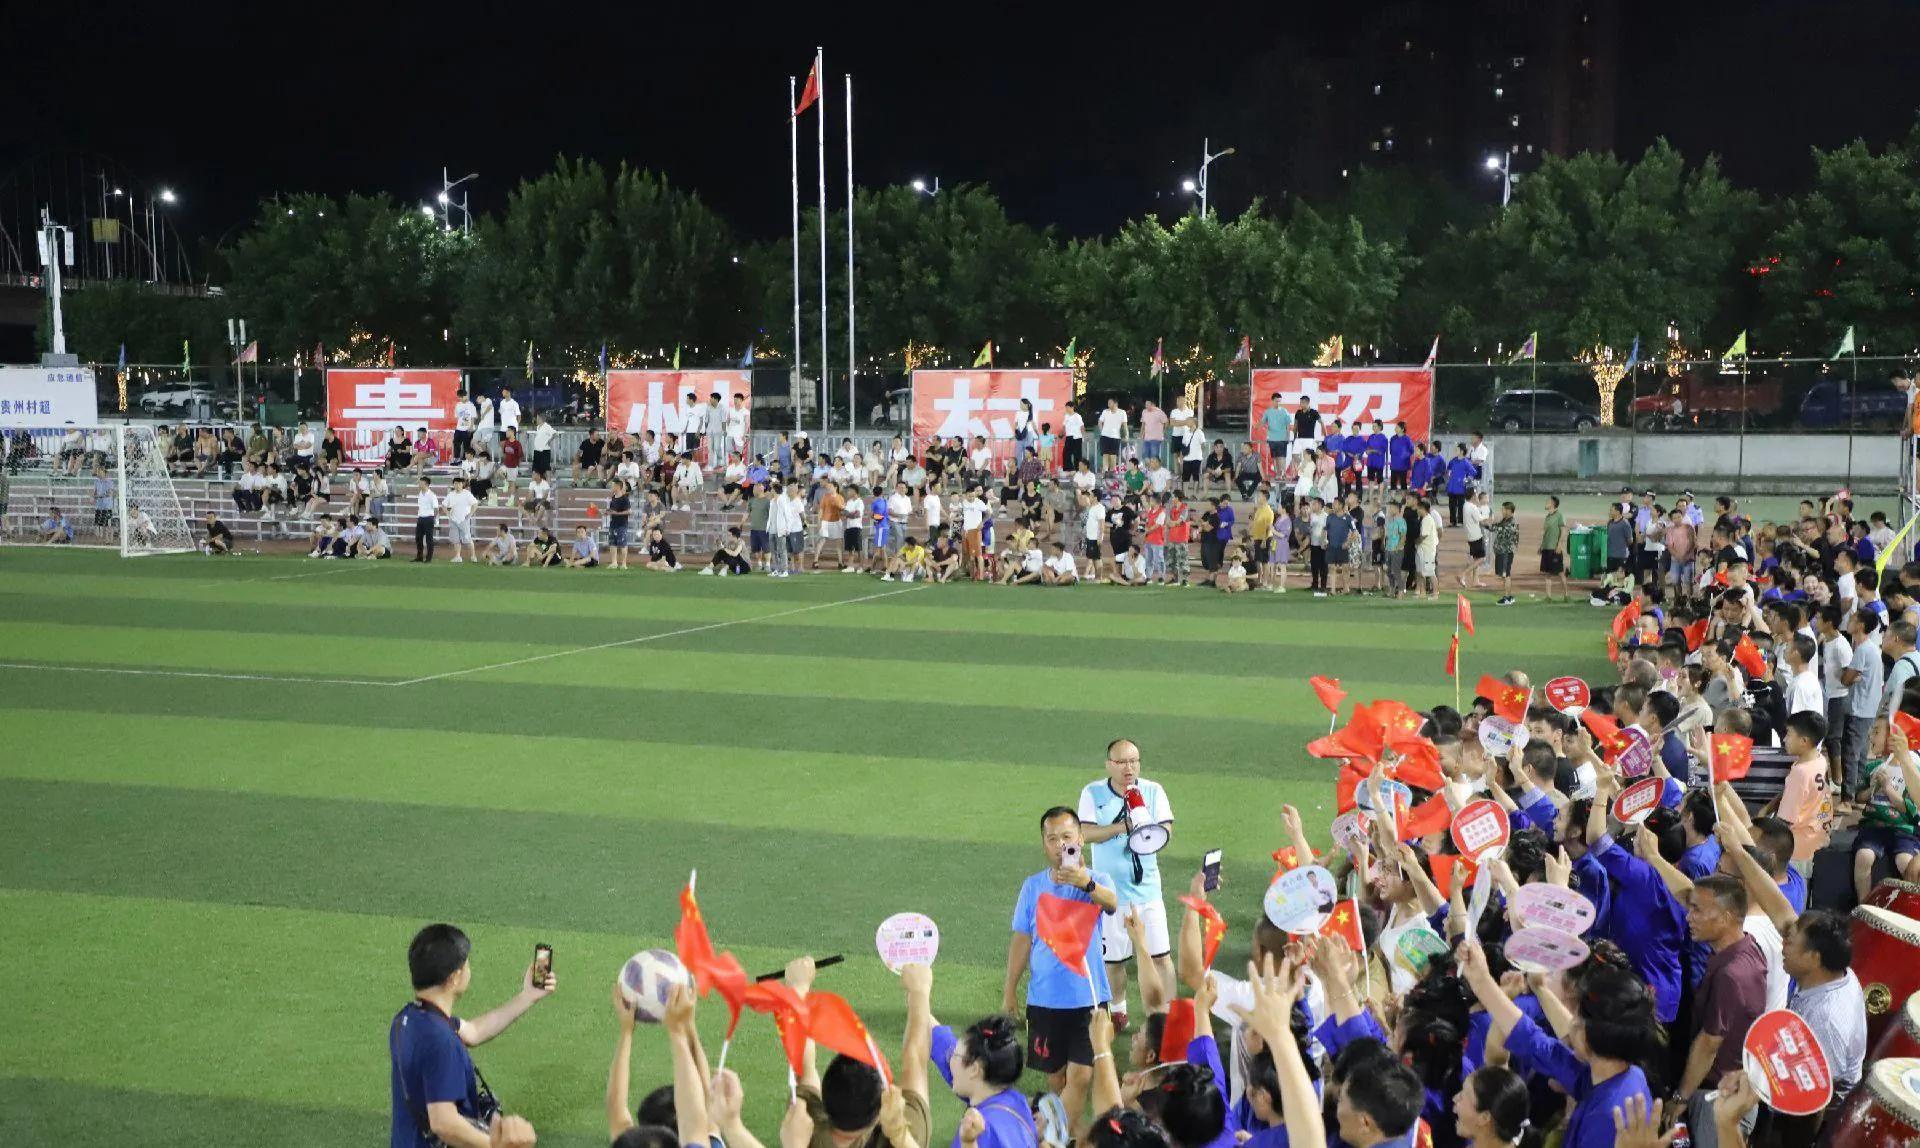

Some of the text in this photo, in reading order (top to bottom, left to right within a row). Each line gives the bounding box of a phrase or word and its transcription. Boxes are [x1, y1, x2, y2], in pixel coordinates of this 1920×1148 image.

[1, 400, 50, 414] 贵州村超
[343, 377, 444, 461] 贵
[934, 378, 1054, 450] 村
